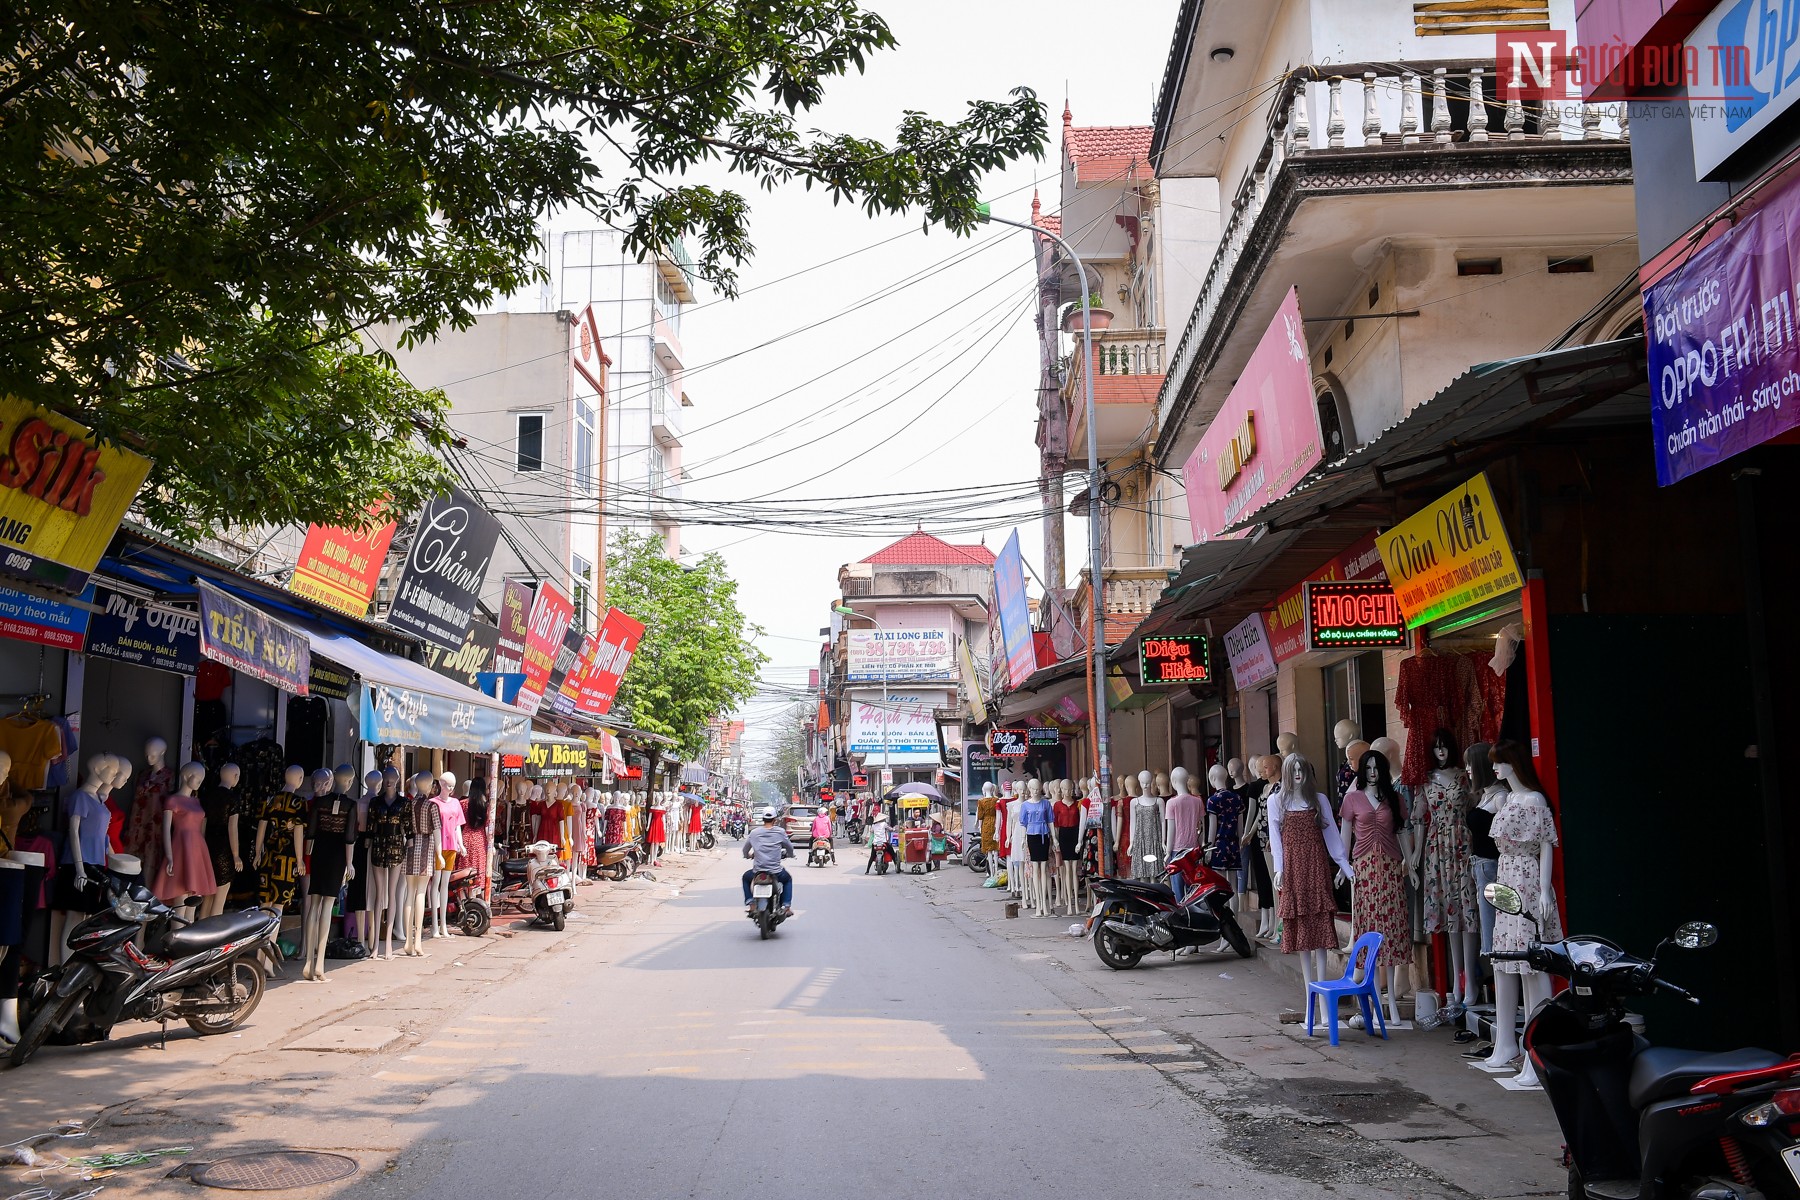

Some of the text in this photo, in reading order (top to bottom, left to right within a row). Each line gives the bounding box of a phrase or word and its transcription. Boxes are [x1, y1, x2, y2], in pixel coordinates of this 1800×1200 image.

[1655, 277, 1720, 346] Đặt trước
[1661, 340, 1718, 410] OPPO
[1721, 316, 1750, 378] F11
[1761, 291, 1792, 356] F11
[1699, 408, 1722, 440] thần
[1722, 393, 1744, 428] thái
[0, 418, 106, 518] Silk
[413, 489, 488, 595] Chảnh
[1389, 493, 1492, 581] Vân Nhi
[5, 552, 33, 572] 0986
[1426, 578, 1439, 598] BÁN
[1452, 564, 1473, 585] TRANG
[1477, 555, 1492, 575] CAO
[1489, 545, 1503, 570] CẤP
[0, 602, 22, 616] may
[24, 605, 47, 620] theo
[106, 594, 139, 632] My
[529, 595, 558, 640] Mai
[1278, 592, 1304, 629] MIN
[1317, 594, 1398, 627] MOCHI
[118, 636, 132, 647] BÁN
[133, 639, 151, 652] BUÔN
[155, 645, 169, 655] BÁN
[209, 609, 257, 656] TIẾN
[262, 636, 296, 674] NGA
[865, 640, 947, 657] 38.736.736
[873, 629, 944, 640] TAXI LONG BIÊN
[1145, 640, 1190, 660] Diệu
[1228, 633, 1245, 660] Diệu
[1320, 630, 1331, 639] ĐỒ
[1331, 630, 1342, 639] BỘ
[1356, 630, 1377, 638] CHÍNH
[1377, 629, 1398, 637] HÃNG
[1160, 658, 1206, 679] Hiền
[859, 703, 901, 729] Hạnh
[525, 743, 549, 768] My
[552, 743, 587, 768] Bông
